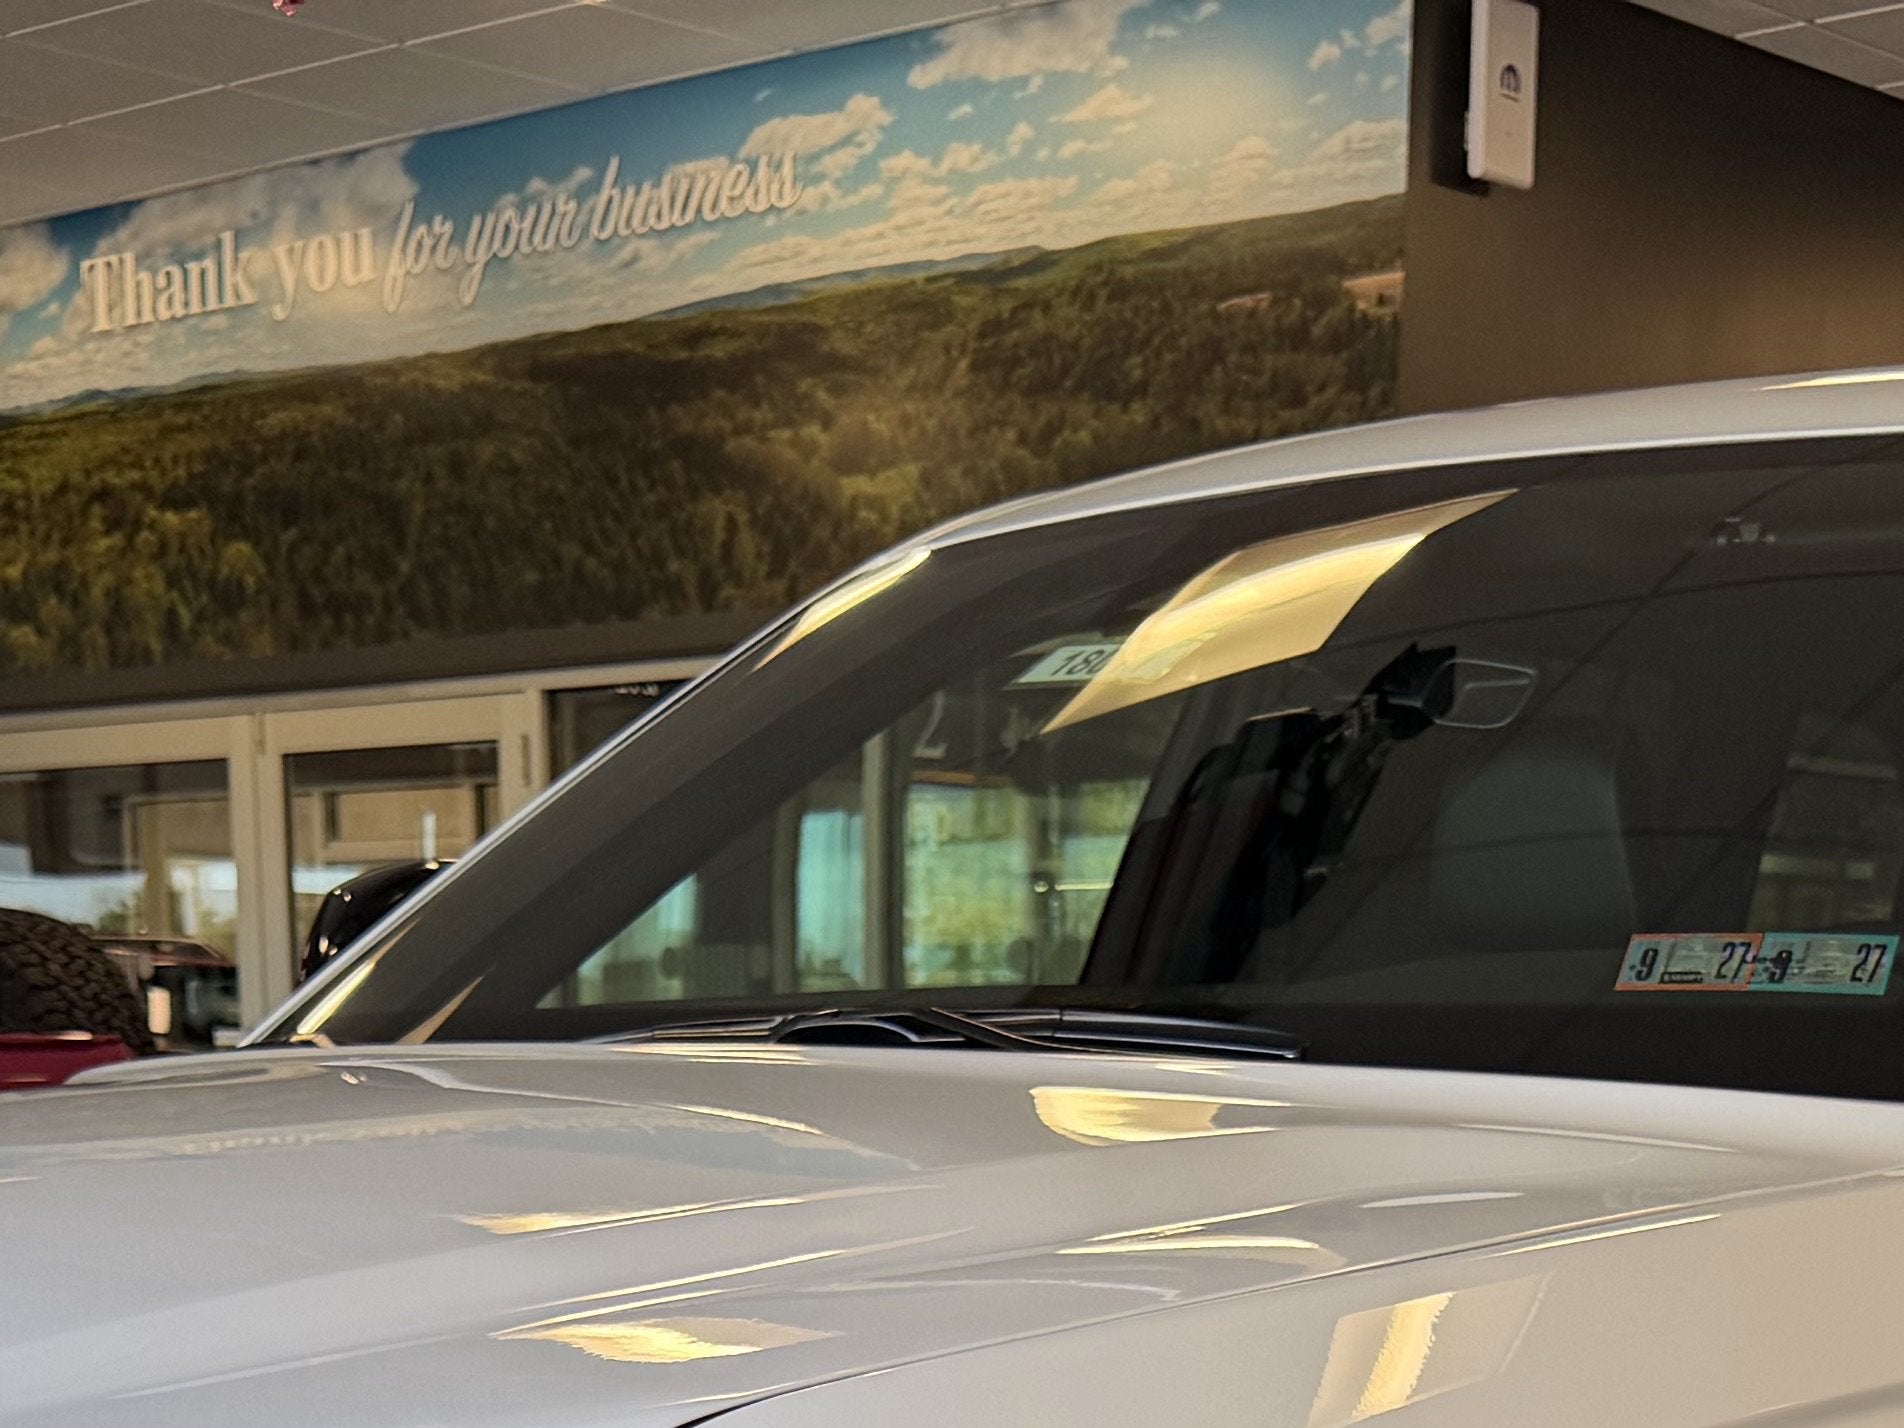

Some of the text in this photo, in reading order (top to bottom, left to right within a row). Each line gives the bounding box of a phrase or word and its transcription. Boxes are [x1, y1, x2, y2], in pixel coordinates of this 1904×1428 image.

[79, 153, 805, 333] Thank you for your business
[1635, 940, 1752, 984] 9 27
[1849, 943, 1887, 984] 27
